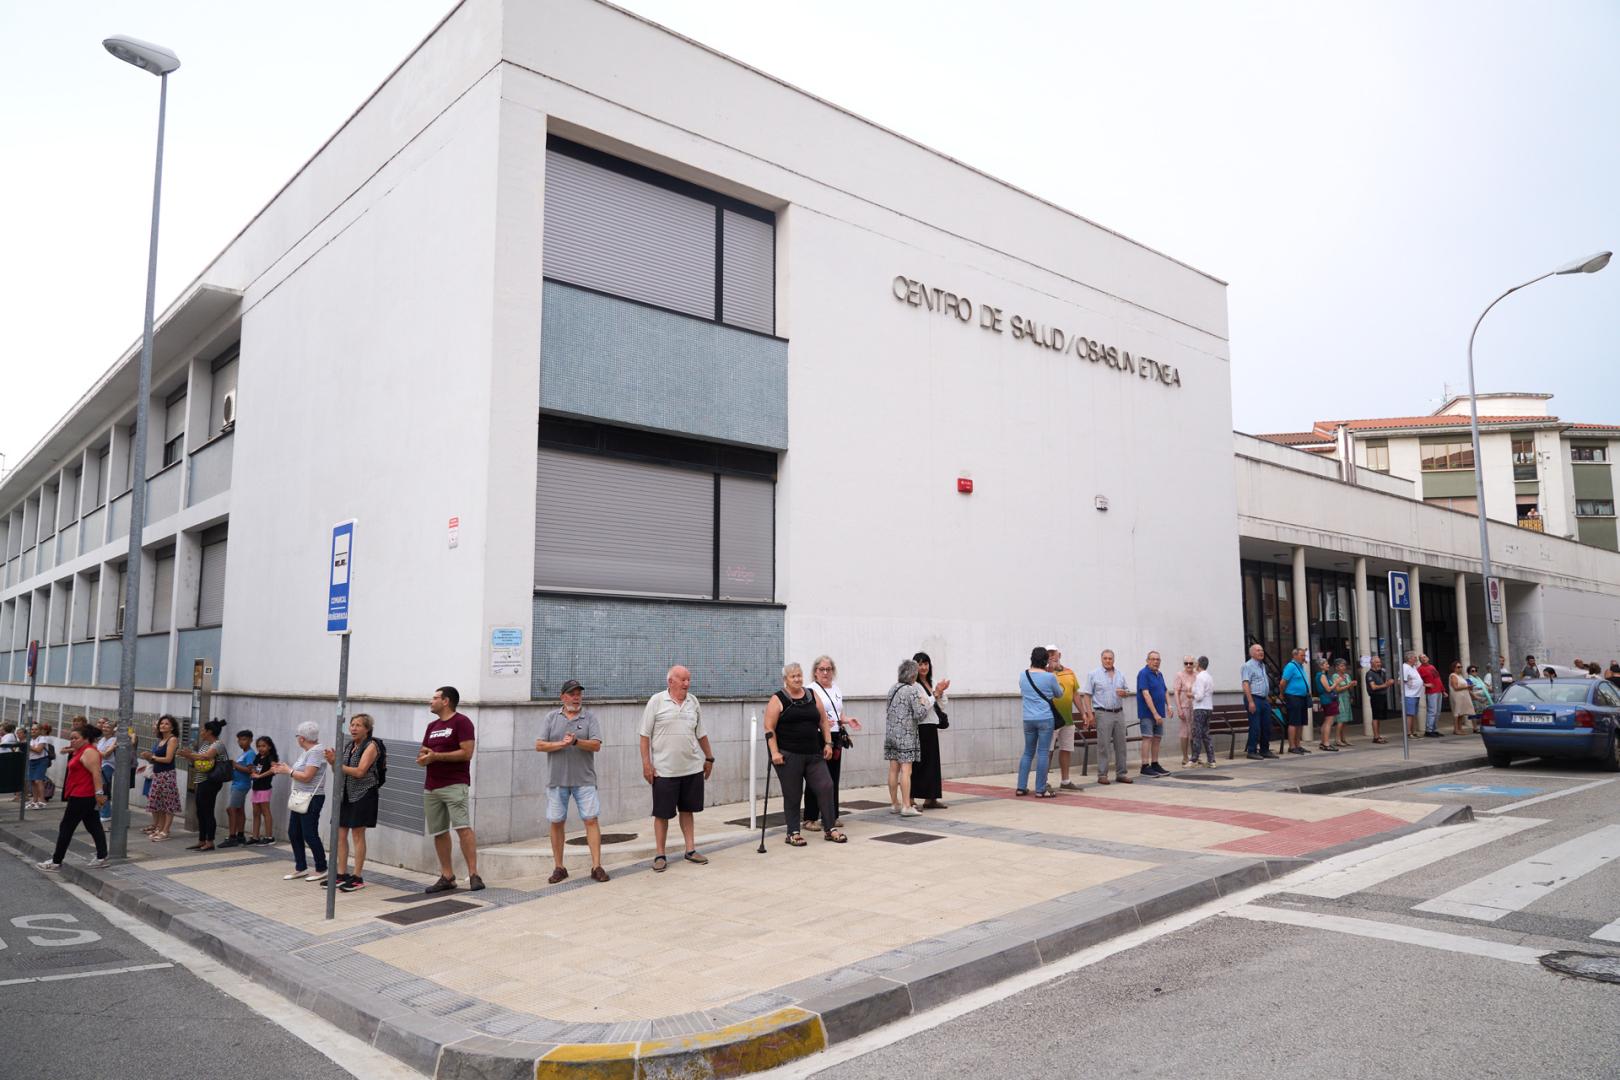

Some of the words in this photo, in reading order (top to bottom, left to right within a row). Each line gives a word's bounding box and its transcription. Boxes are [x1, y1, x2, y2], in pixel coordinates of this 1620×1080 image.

[892, 274, 973, 322] CENTRO
[980, 303, 1004, 334] DE
[1138, 356, 1182, 388] ETXEA
[1394, 576, 1406, 605] P
